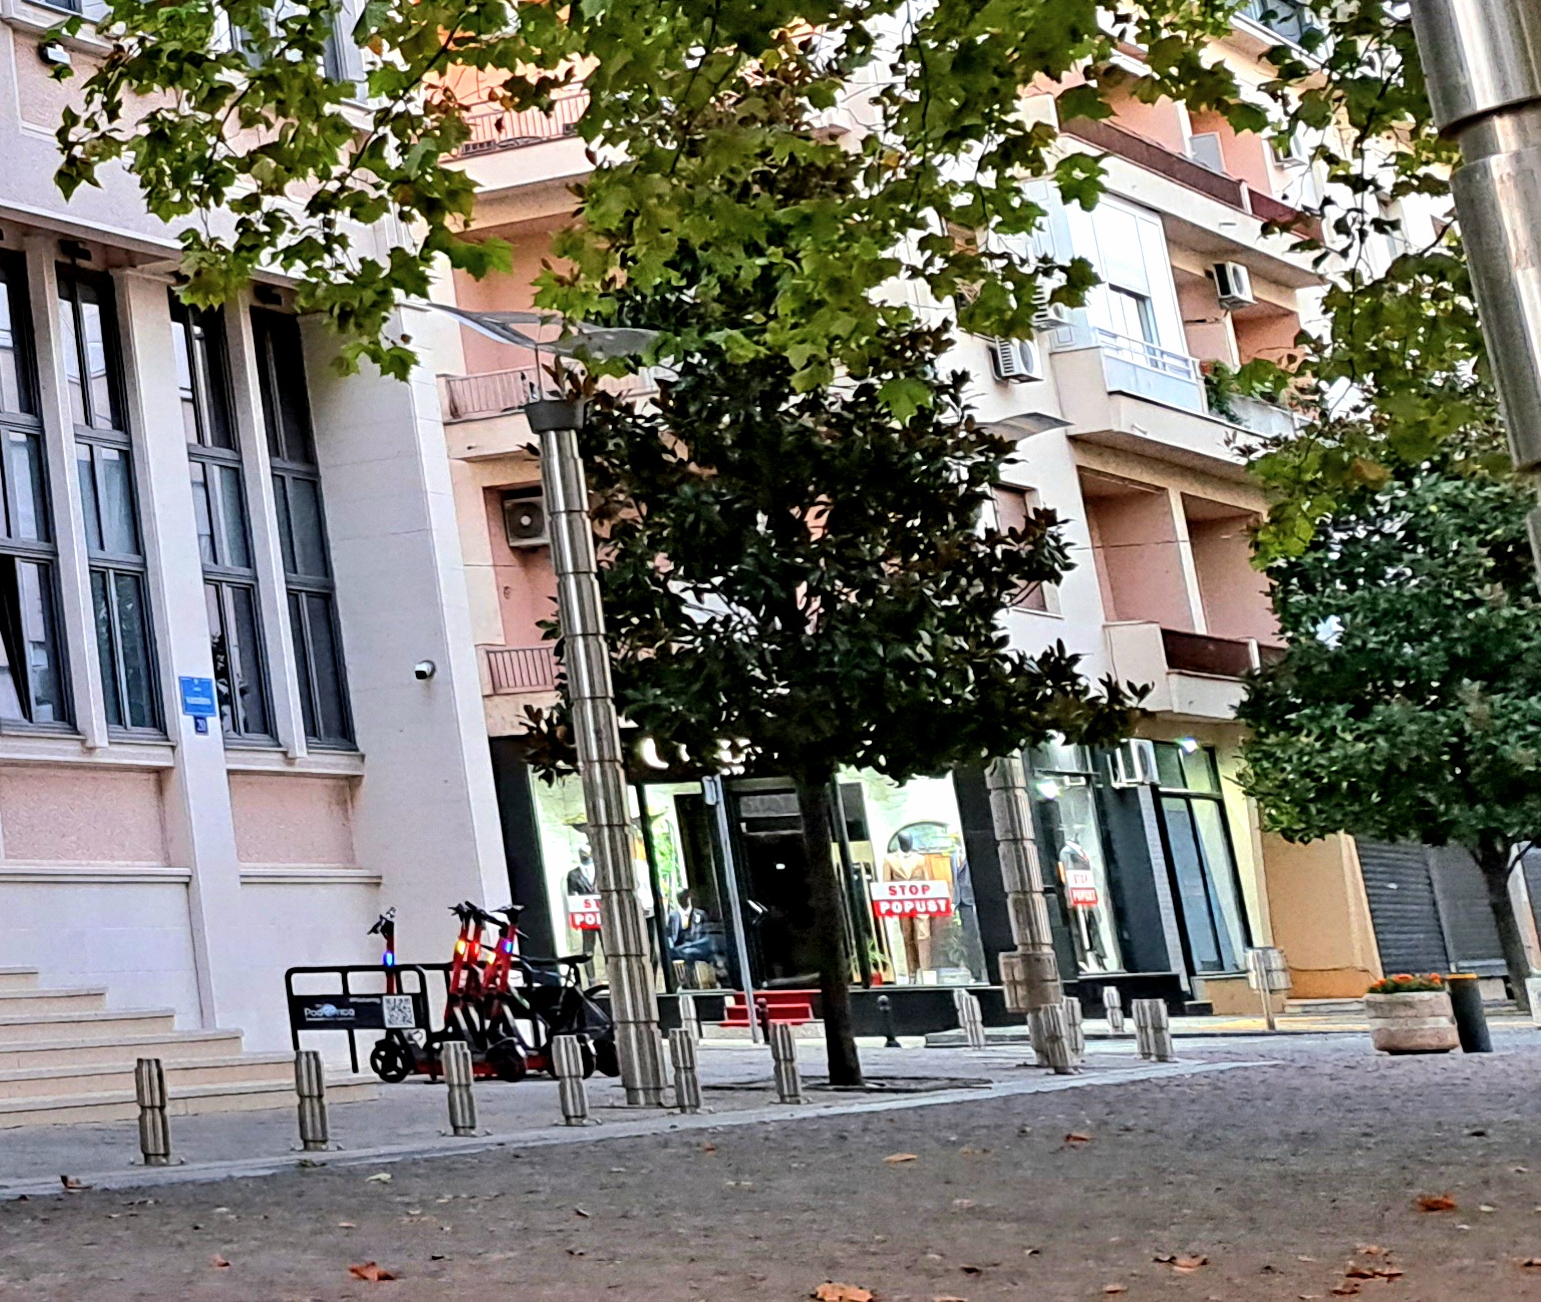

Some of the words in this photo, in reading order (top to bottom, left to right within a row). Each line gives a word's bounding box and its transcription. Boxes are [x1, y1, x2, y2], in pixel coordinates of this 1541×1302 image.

[888, 884, 931, 896] STOP
[583, 899, 601, 908] ST
[879, 899, 946, 914] POPUST
